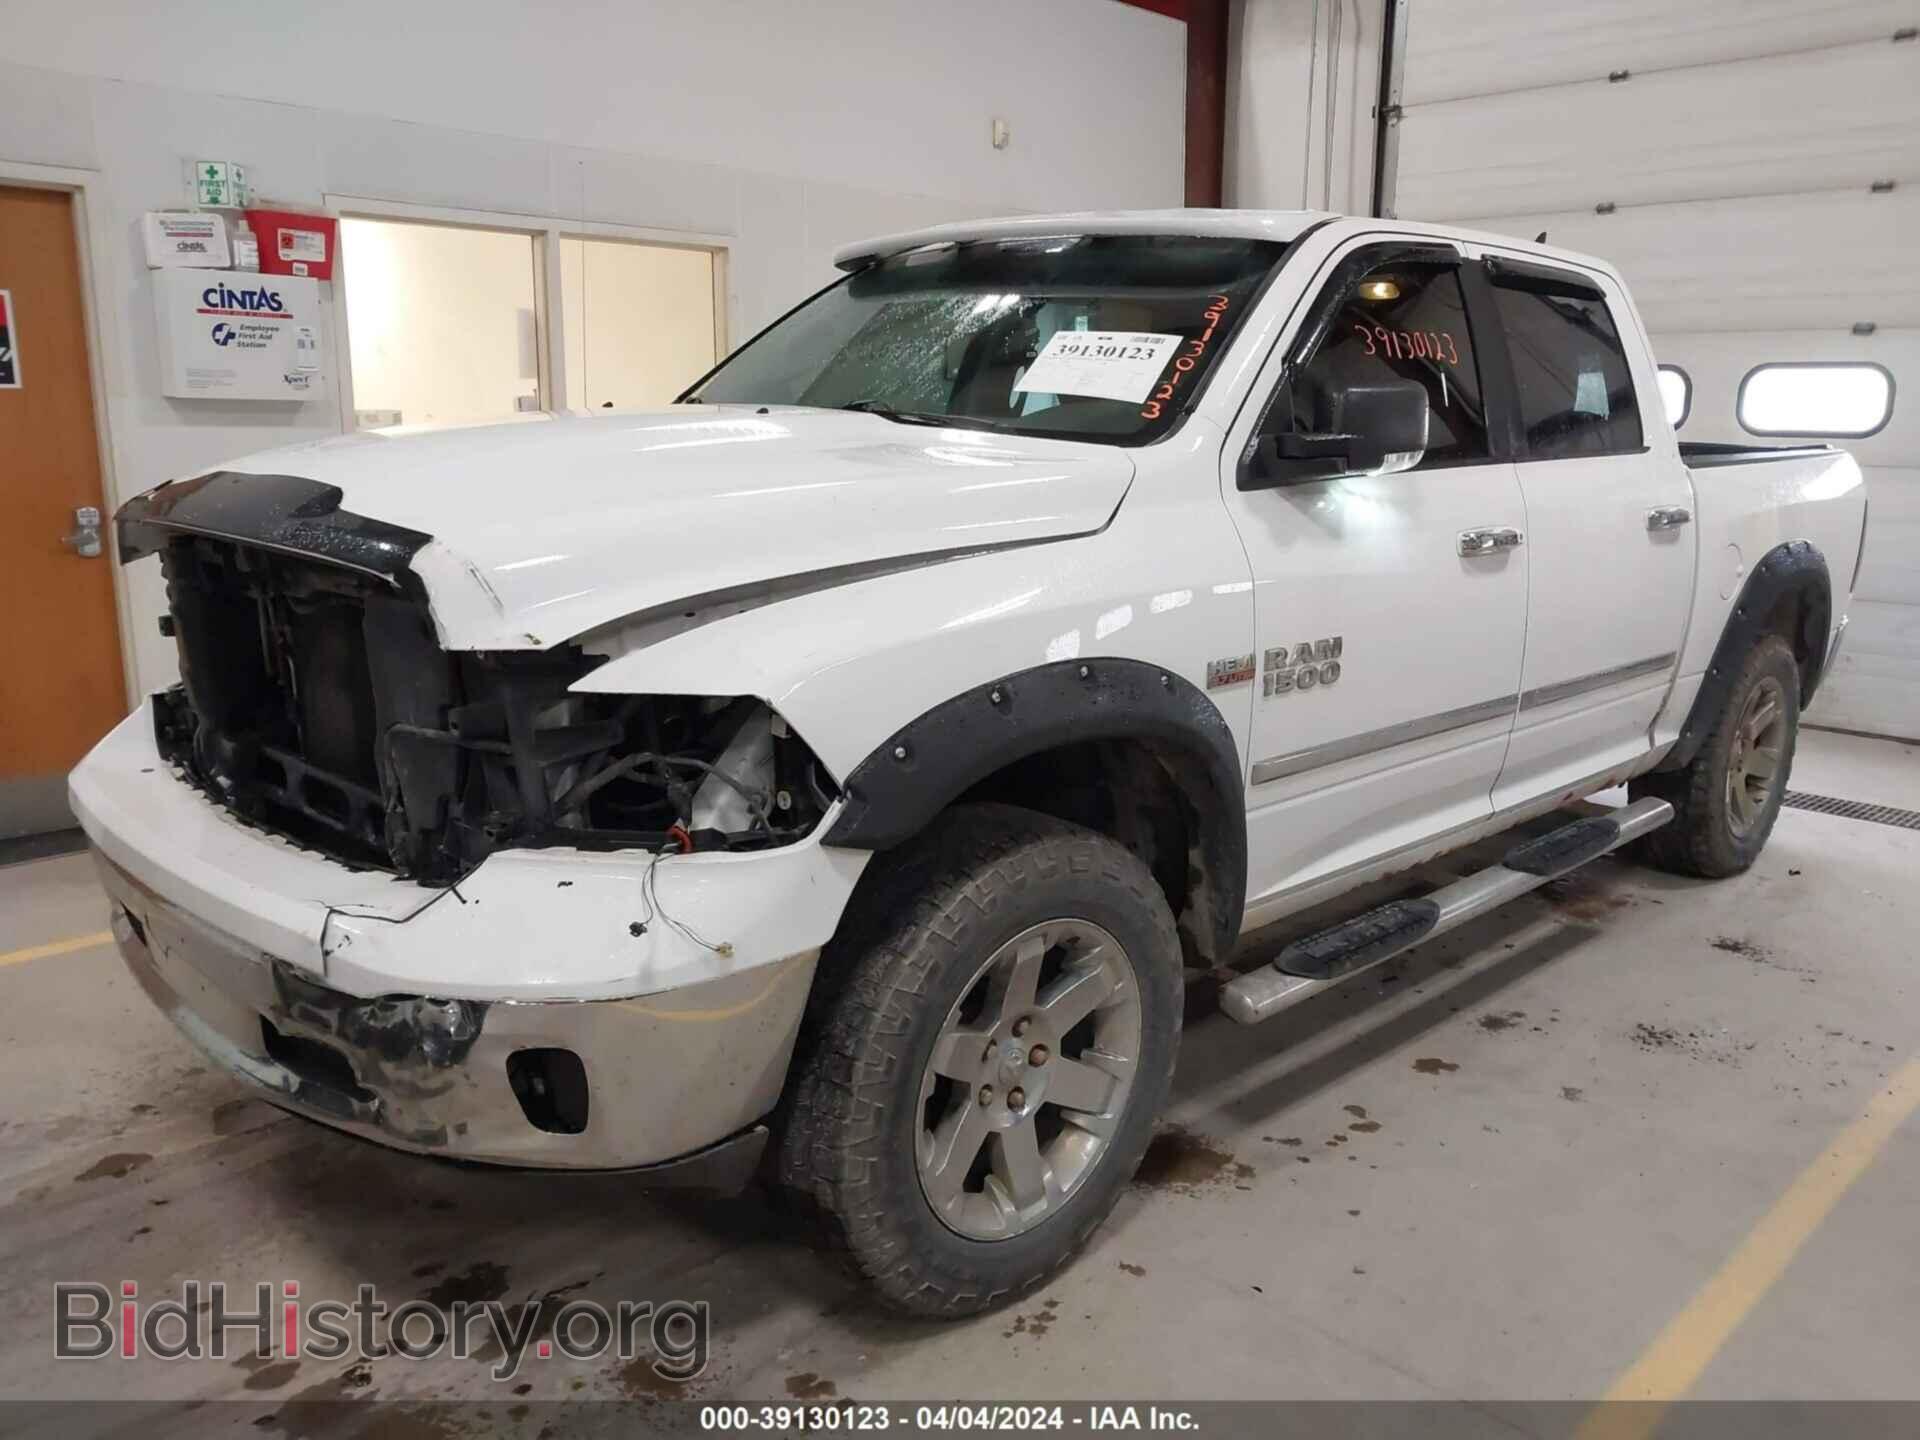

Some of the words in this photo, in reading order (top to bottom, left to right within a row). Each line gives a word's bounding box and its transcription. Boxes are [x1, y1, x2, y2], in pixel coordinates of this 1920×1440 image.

[1052, 344, 1156, 361] 39130123
[1140, 295, 1229, 419] 39130123
[1354, 324, 1458, 364] 39130123
[1263, 636, 1343, 672] RAM
[1263, 660, 1341, 697] 1500
